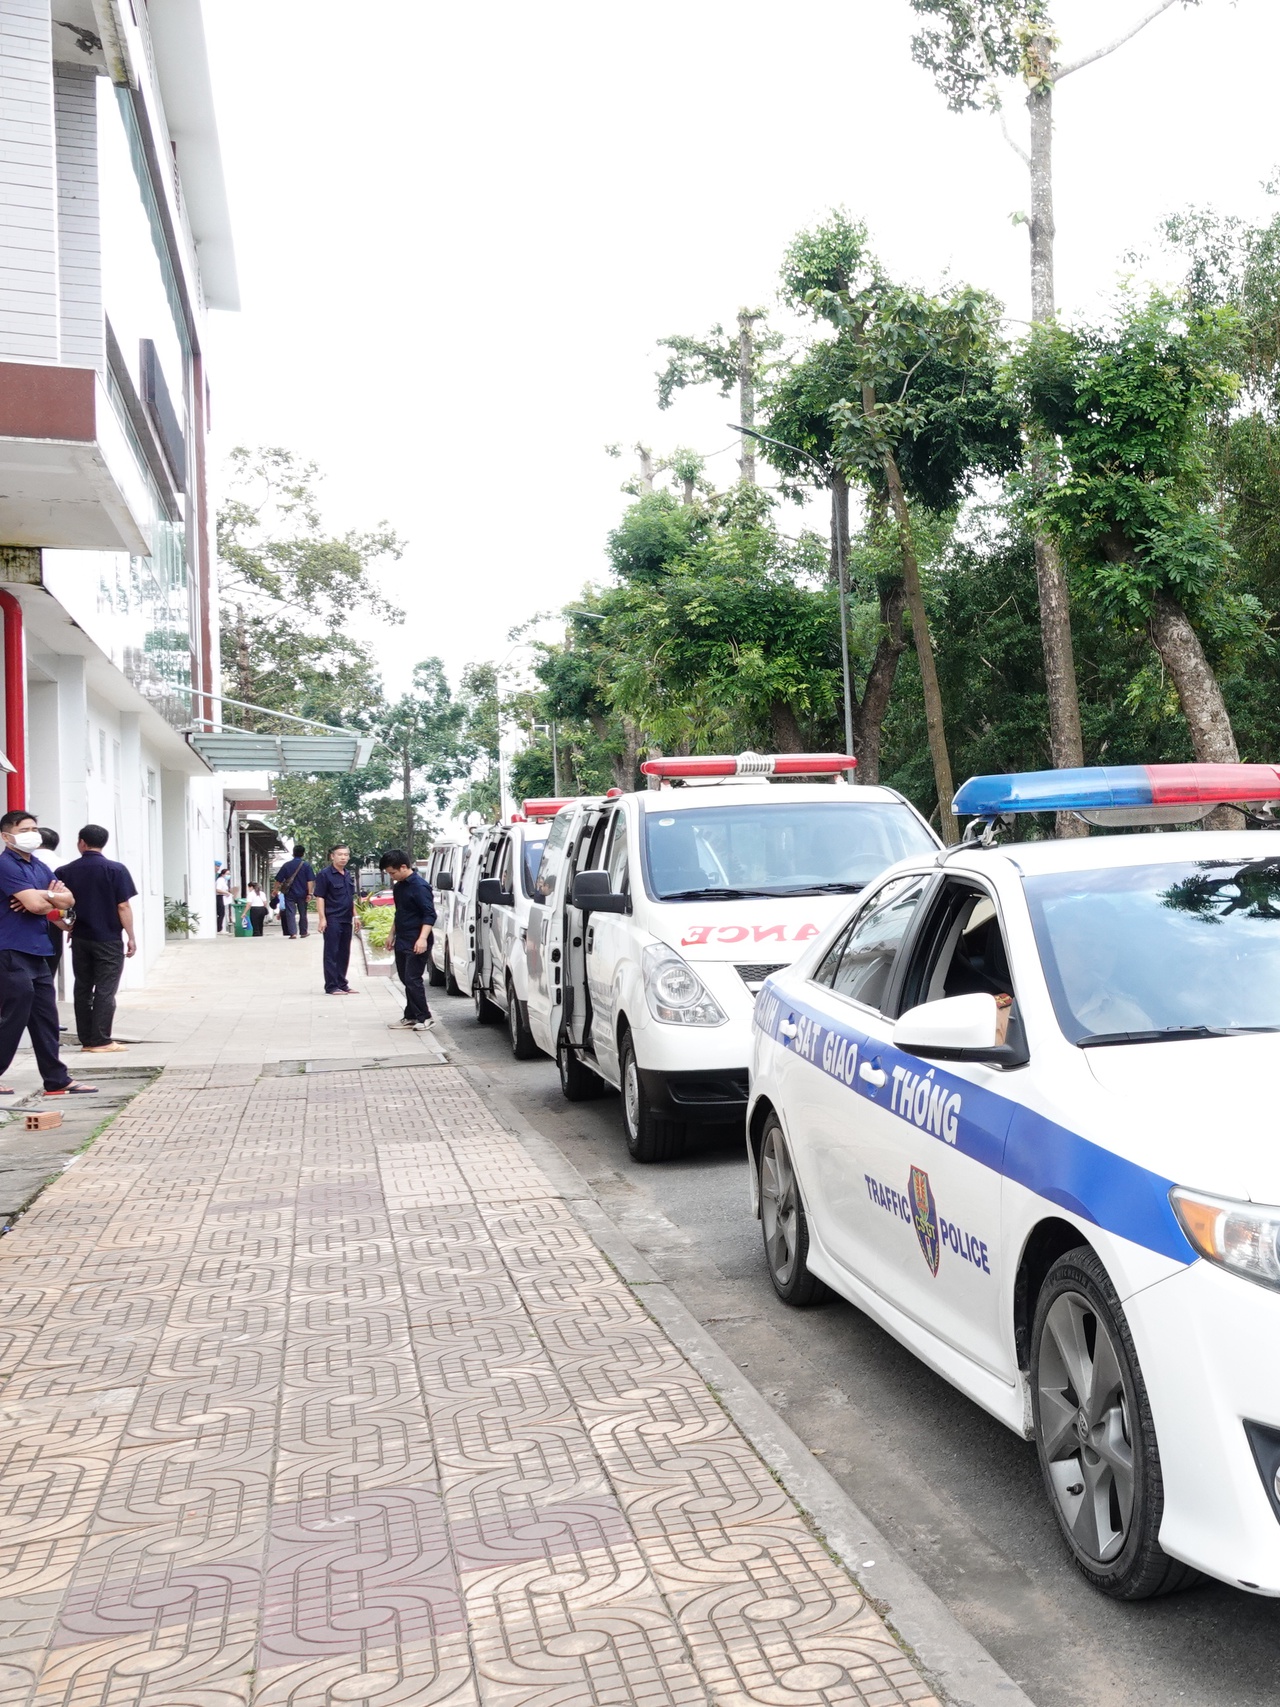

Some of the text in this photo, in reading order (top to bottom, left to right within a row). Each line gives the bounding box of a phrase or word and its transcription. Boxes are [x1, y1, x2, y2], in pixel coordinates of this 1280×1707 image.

[822, 1031, 859, 1086] GIAO
[890, 1065, 962, 1145] THÔNG
[864, 1174, 991, 1275] TRAFFIC POLICE
